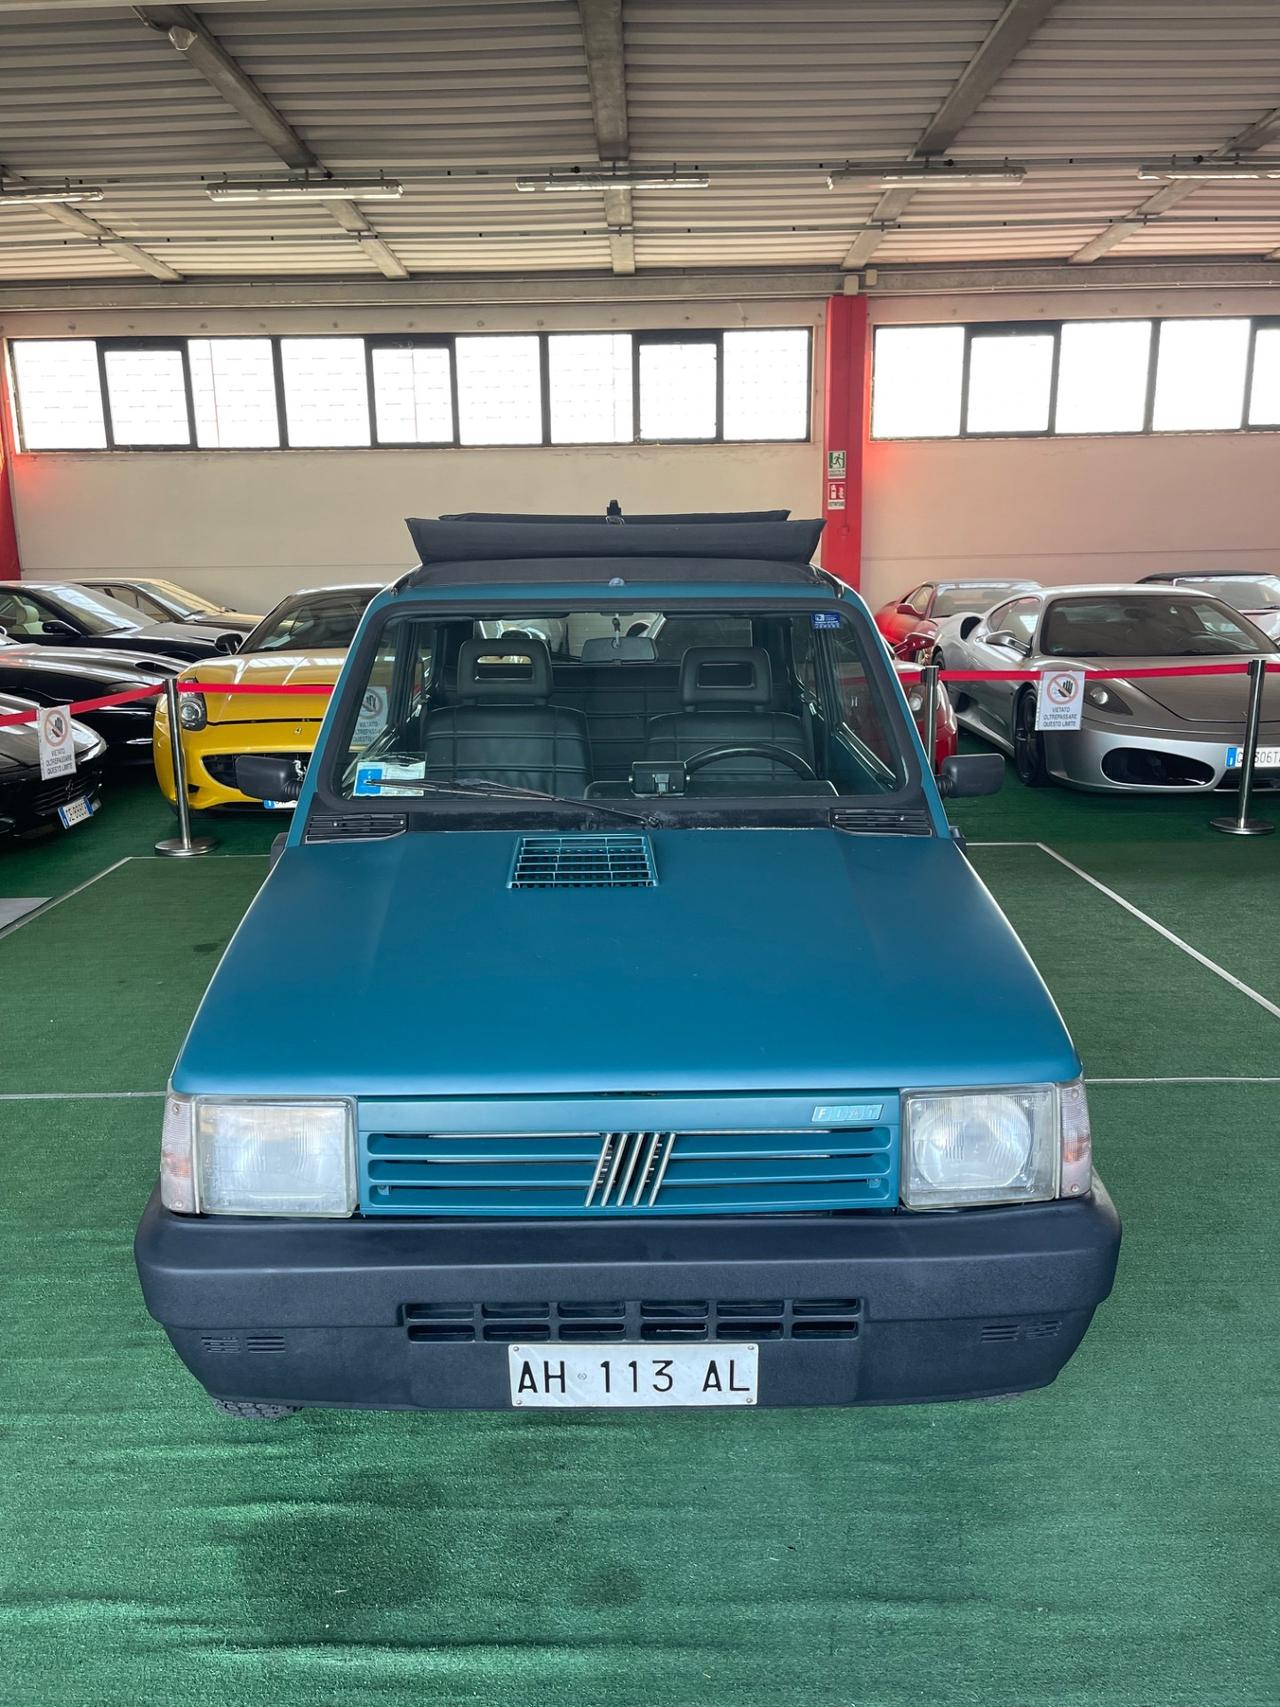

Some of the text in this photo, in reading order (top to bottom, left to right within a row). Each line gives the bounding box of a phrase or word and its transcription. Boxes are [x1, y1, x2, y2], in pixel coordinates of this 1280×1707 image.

[517, 1359, 750, 1393] AH 113 AL
